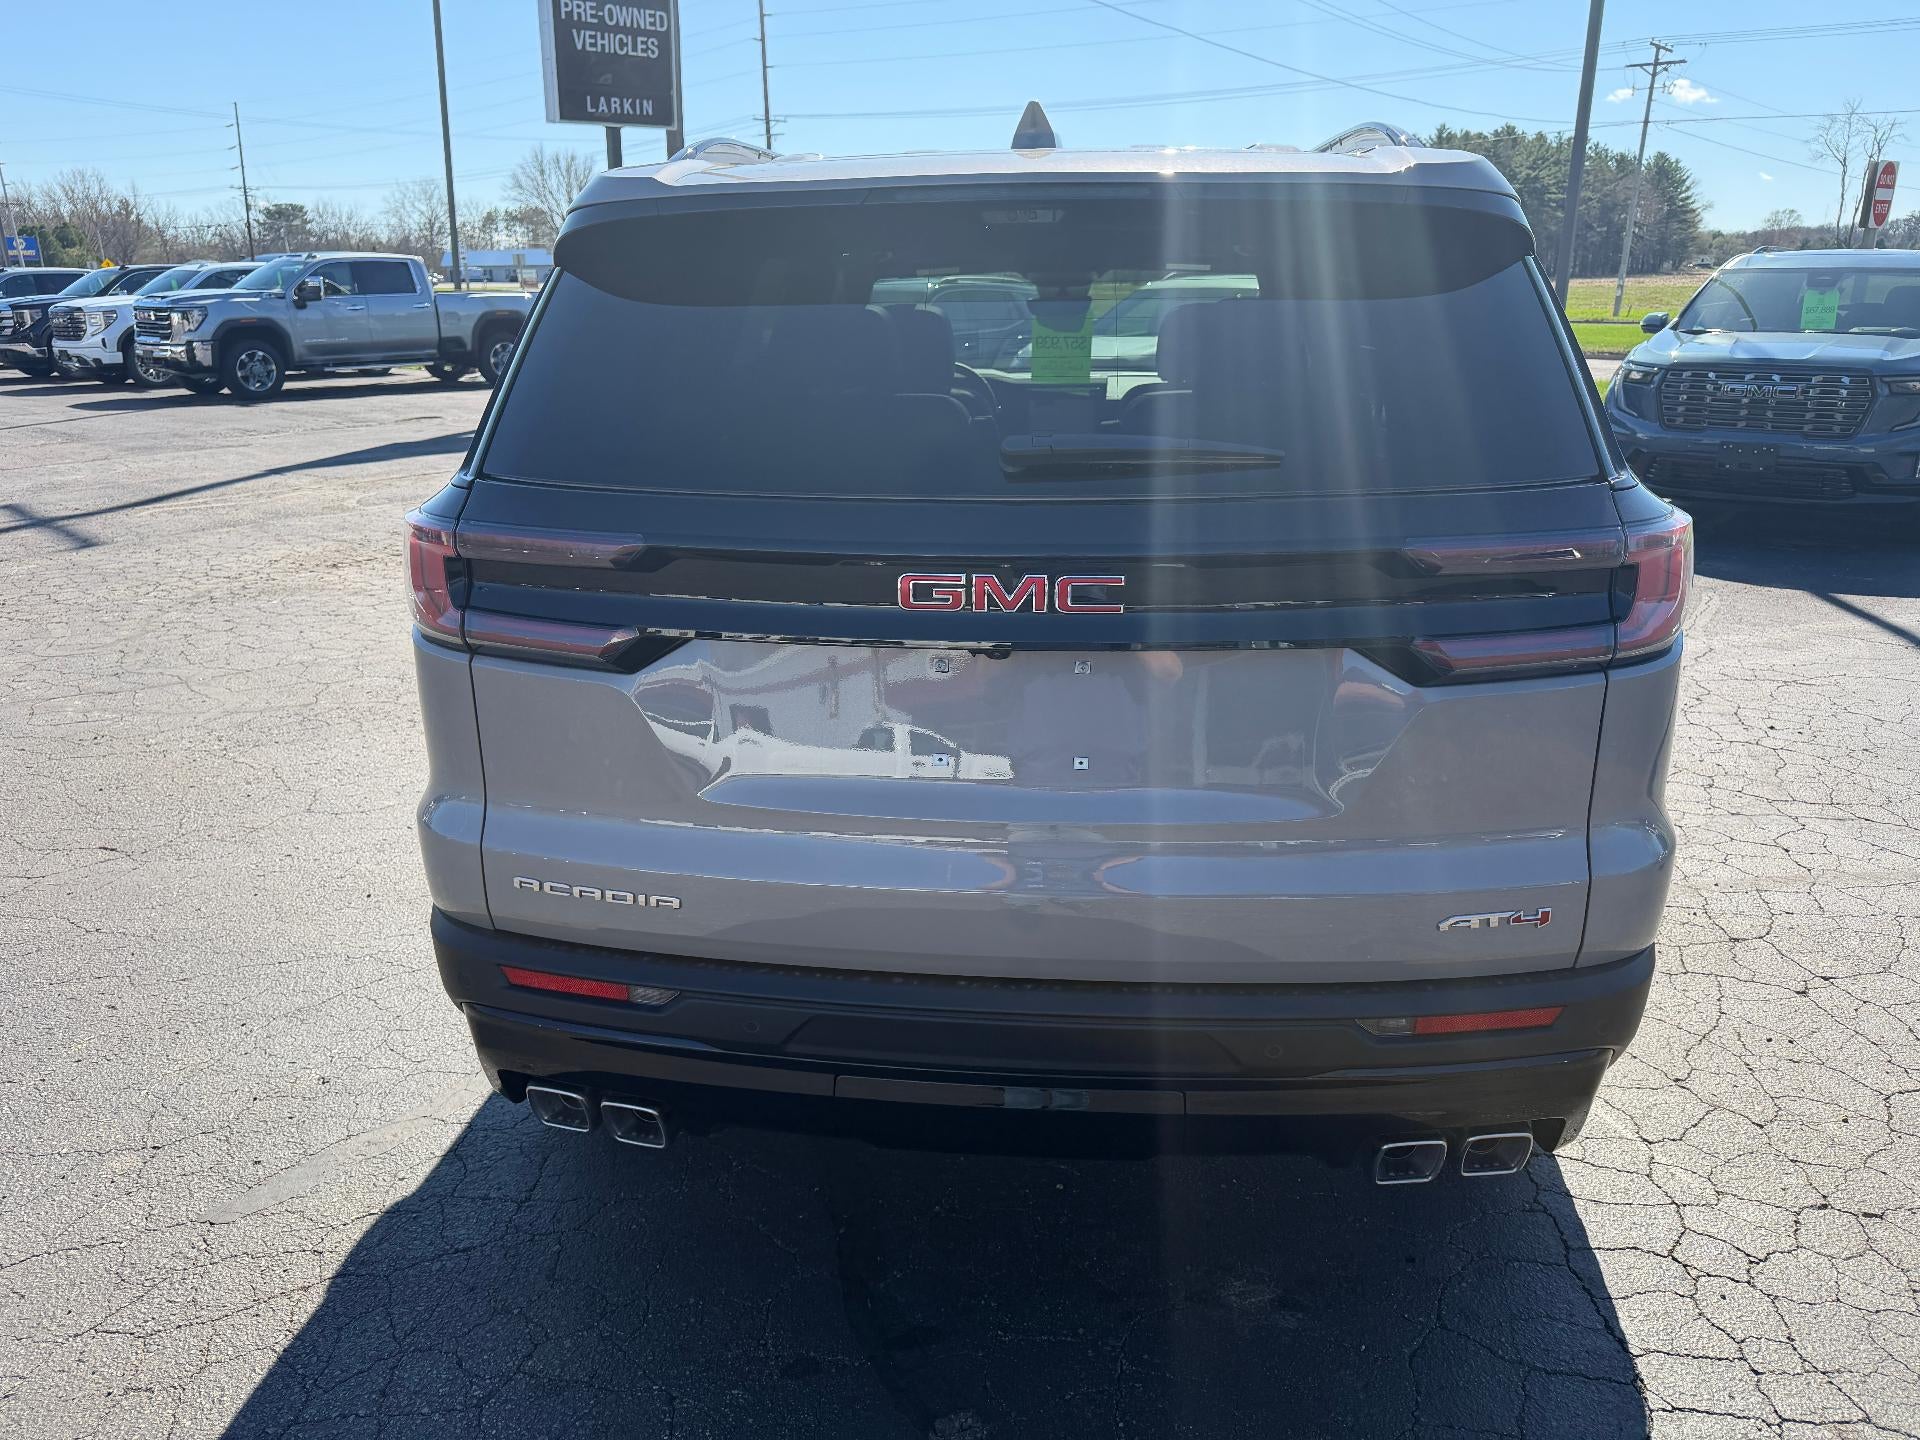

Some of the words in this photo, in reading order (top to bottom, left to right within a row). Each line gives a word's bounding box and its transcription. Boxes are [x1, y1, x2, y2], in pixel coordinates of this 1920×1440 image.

[560, 0, 668, 31] PRE-OWNED
[572, 29, 659, 58] VEHICLES
[586, 95, 653, 116] LARKIN
[1875, 203, 1889, 214] ENTER
[1722, 383, 1798, 399] GMC
[898, 573, 1125, 614] GMC
[513, 876, 683, 909] ACADIA
[1439, 907, 1552, 931] AT4
